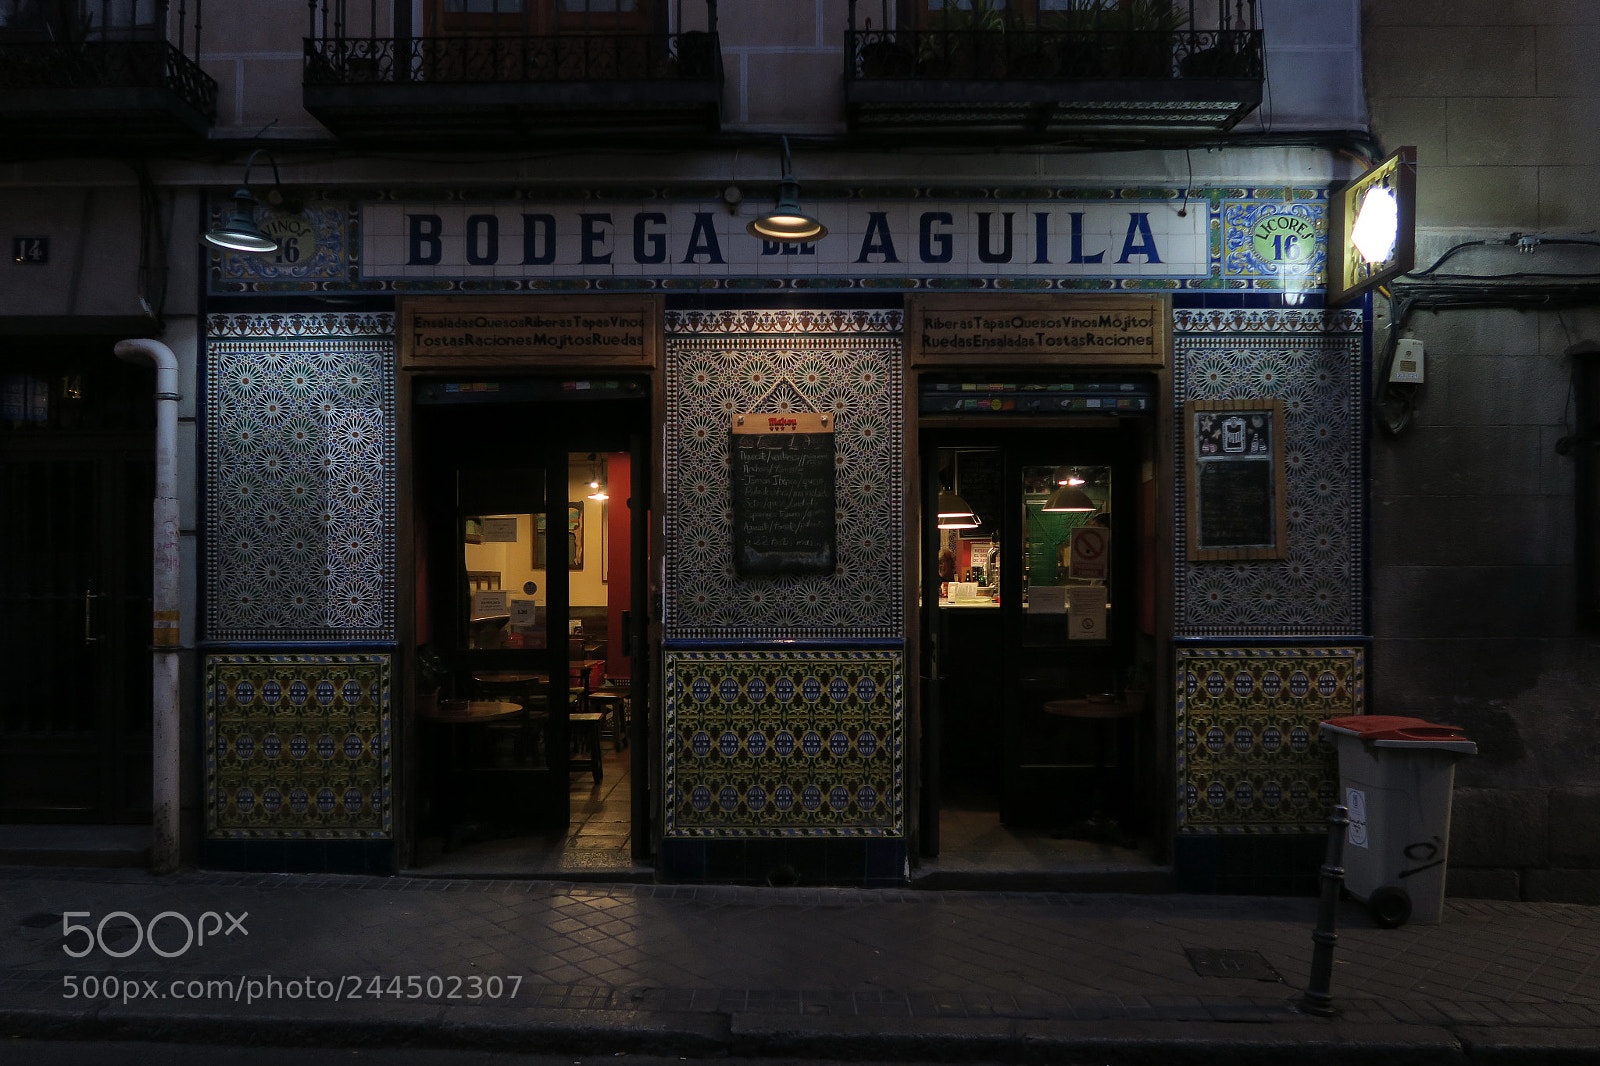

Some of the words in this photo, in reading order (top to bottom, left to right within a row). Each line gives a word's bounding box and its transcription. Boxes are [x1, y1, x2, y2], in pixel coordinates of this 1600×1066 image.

[260, 220, 311, 237] VINOS
[406, 212, 727, 266] BODEGA
[850, 211, 1165, 264] AGUILA
[1255, 216, 1315, 241] LICORES
[20, 240, 42, 259] 14
[274, 237, 300, 263] 16
[1271, 234, 1299, 261] 16
